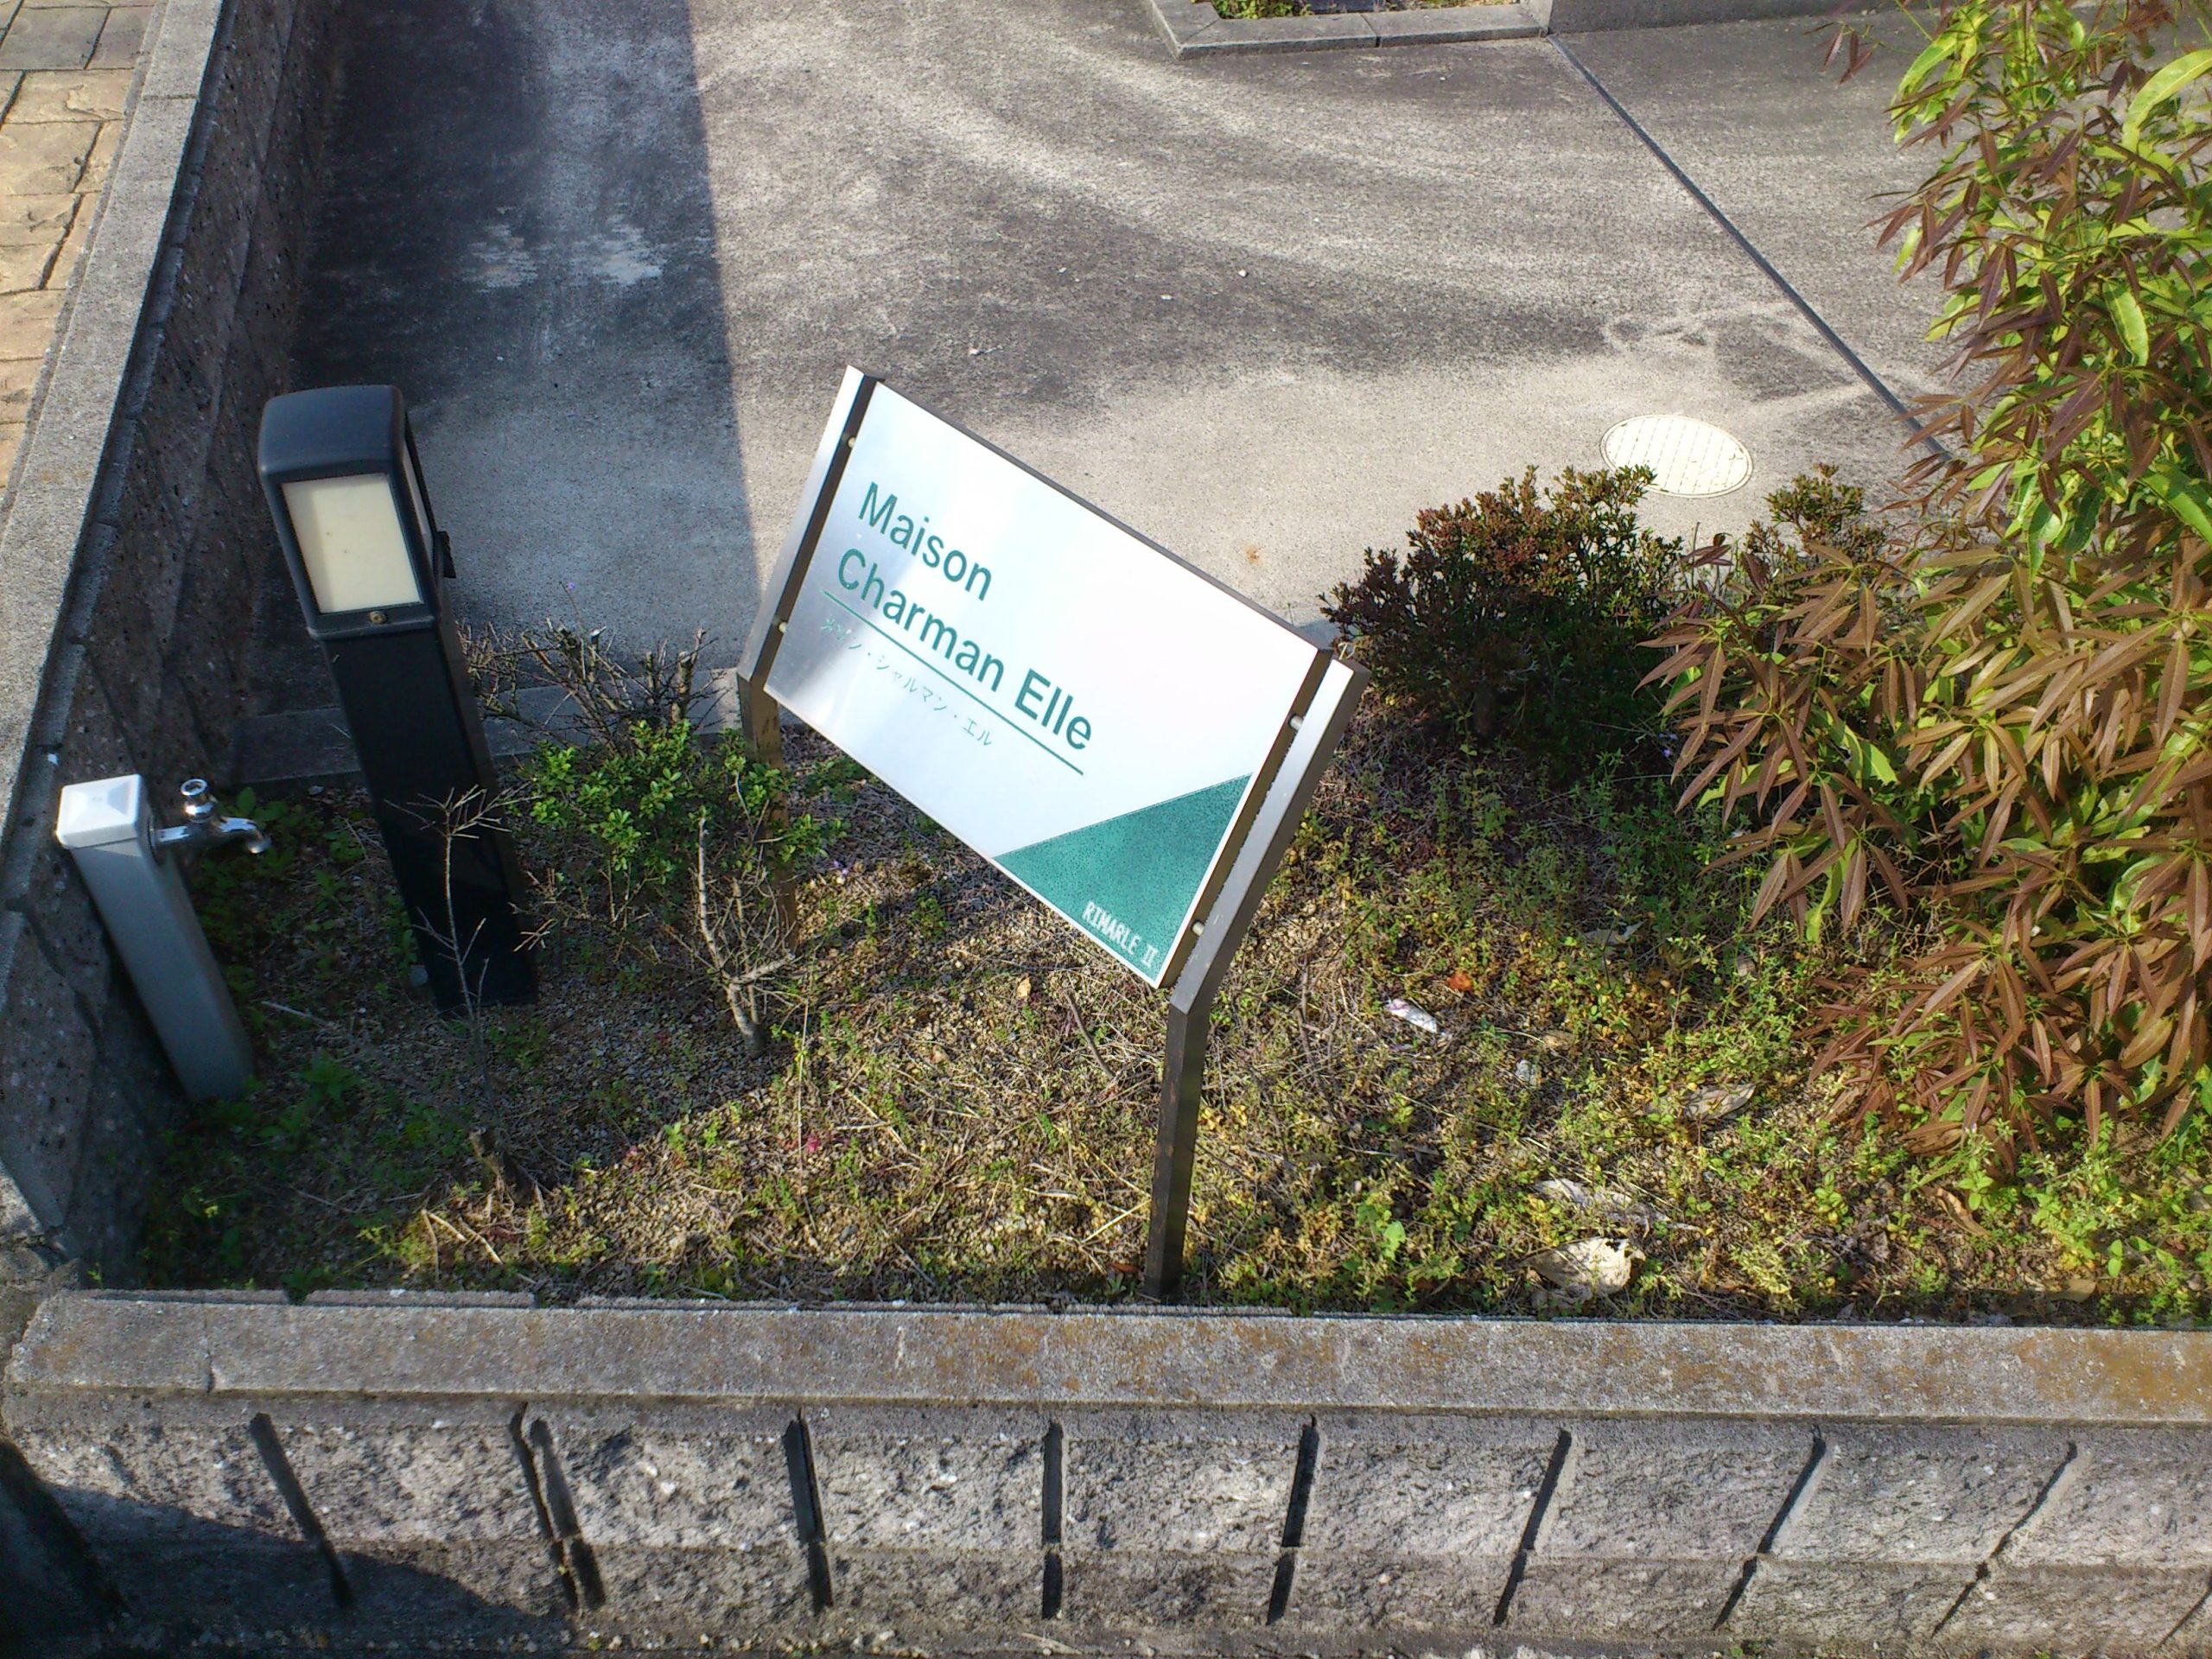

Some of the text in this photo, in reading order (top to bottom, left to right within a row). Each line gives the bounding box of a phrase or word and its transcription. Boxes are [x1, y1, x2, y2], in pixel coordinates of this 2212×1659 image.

[858, 481, 992, 601] Maison
[838, 548, 1092, 750] Charman Elle
[1082, 901, 1141, 956] RIMARLE
